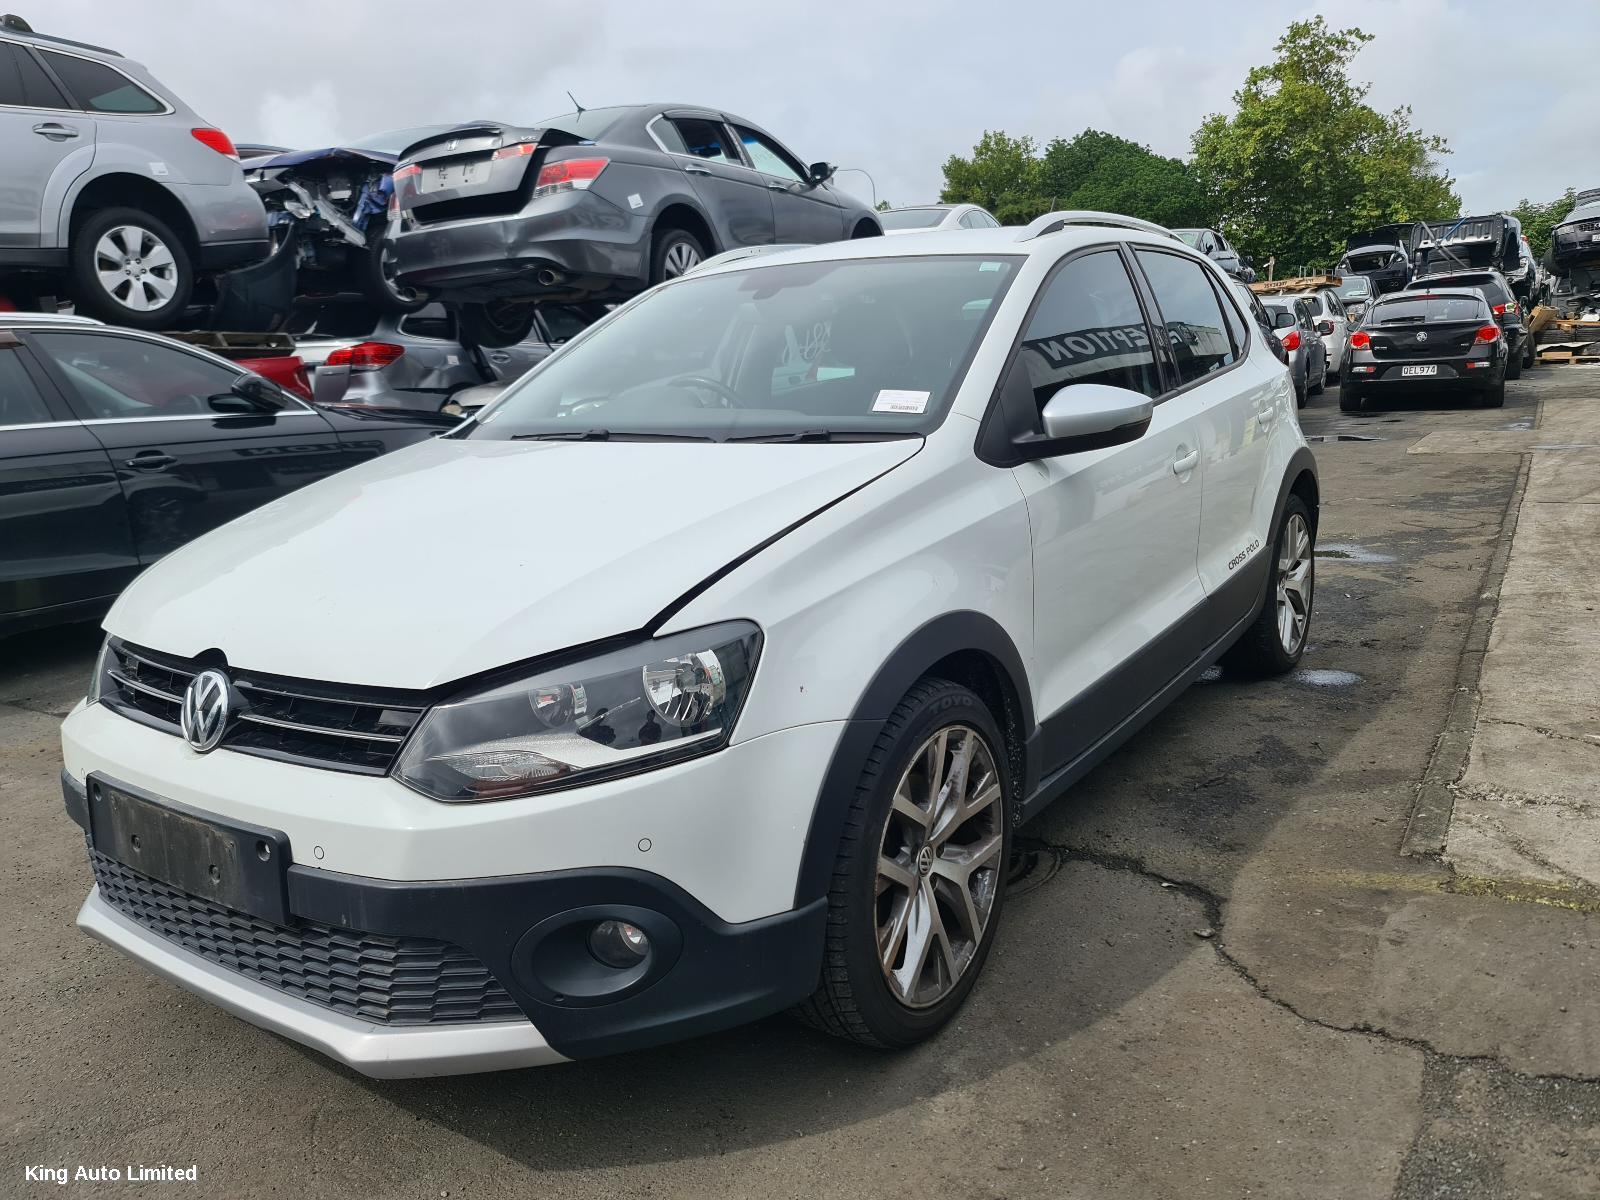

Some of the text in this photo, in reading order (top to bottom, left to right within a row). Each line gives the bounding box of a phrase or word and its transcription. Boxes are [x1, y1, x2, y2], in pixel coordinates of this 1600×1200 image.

[1228, 539, 1260, 570] CROSS POLO
[928, 695, 973, 715] TOYO
